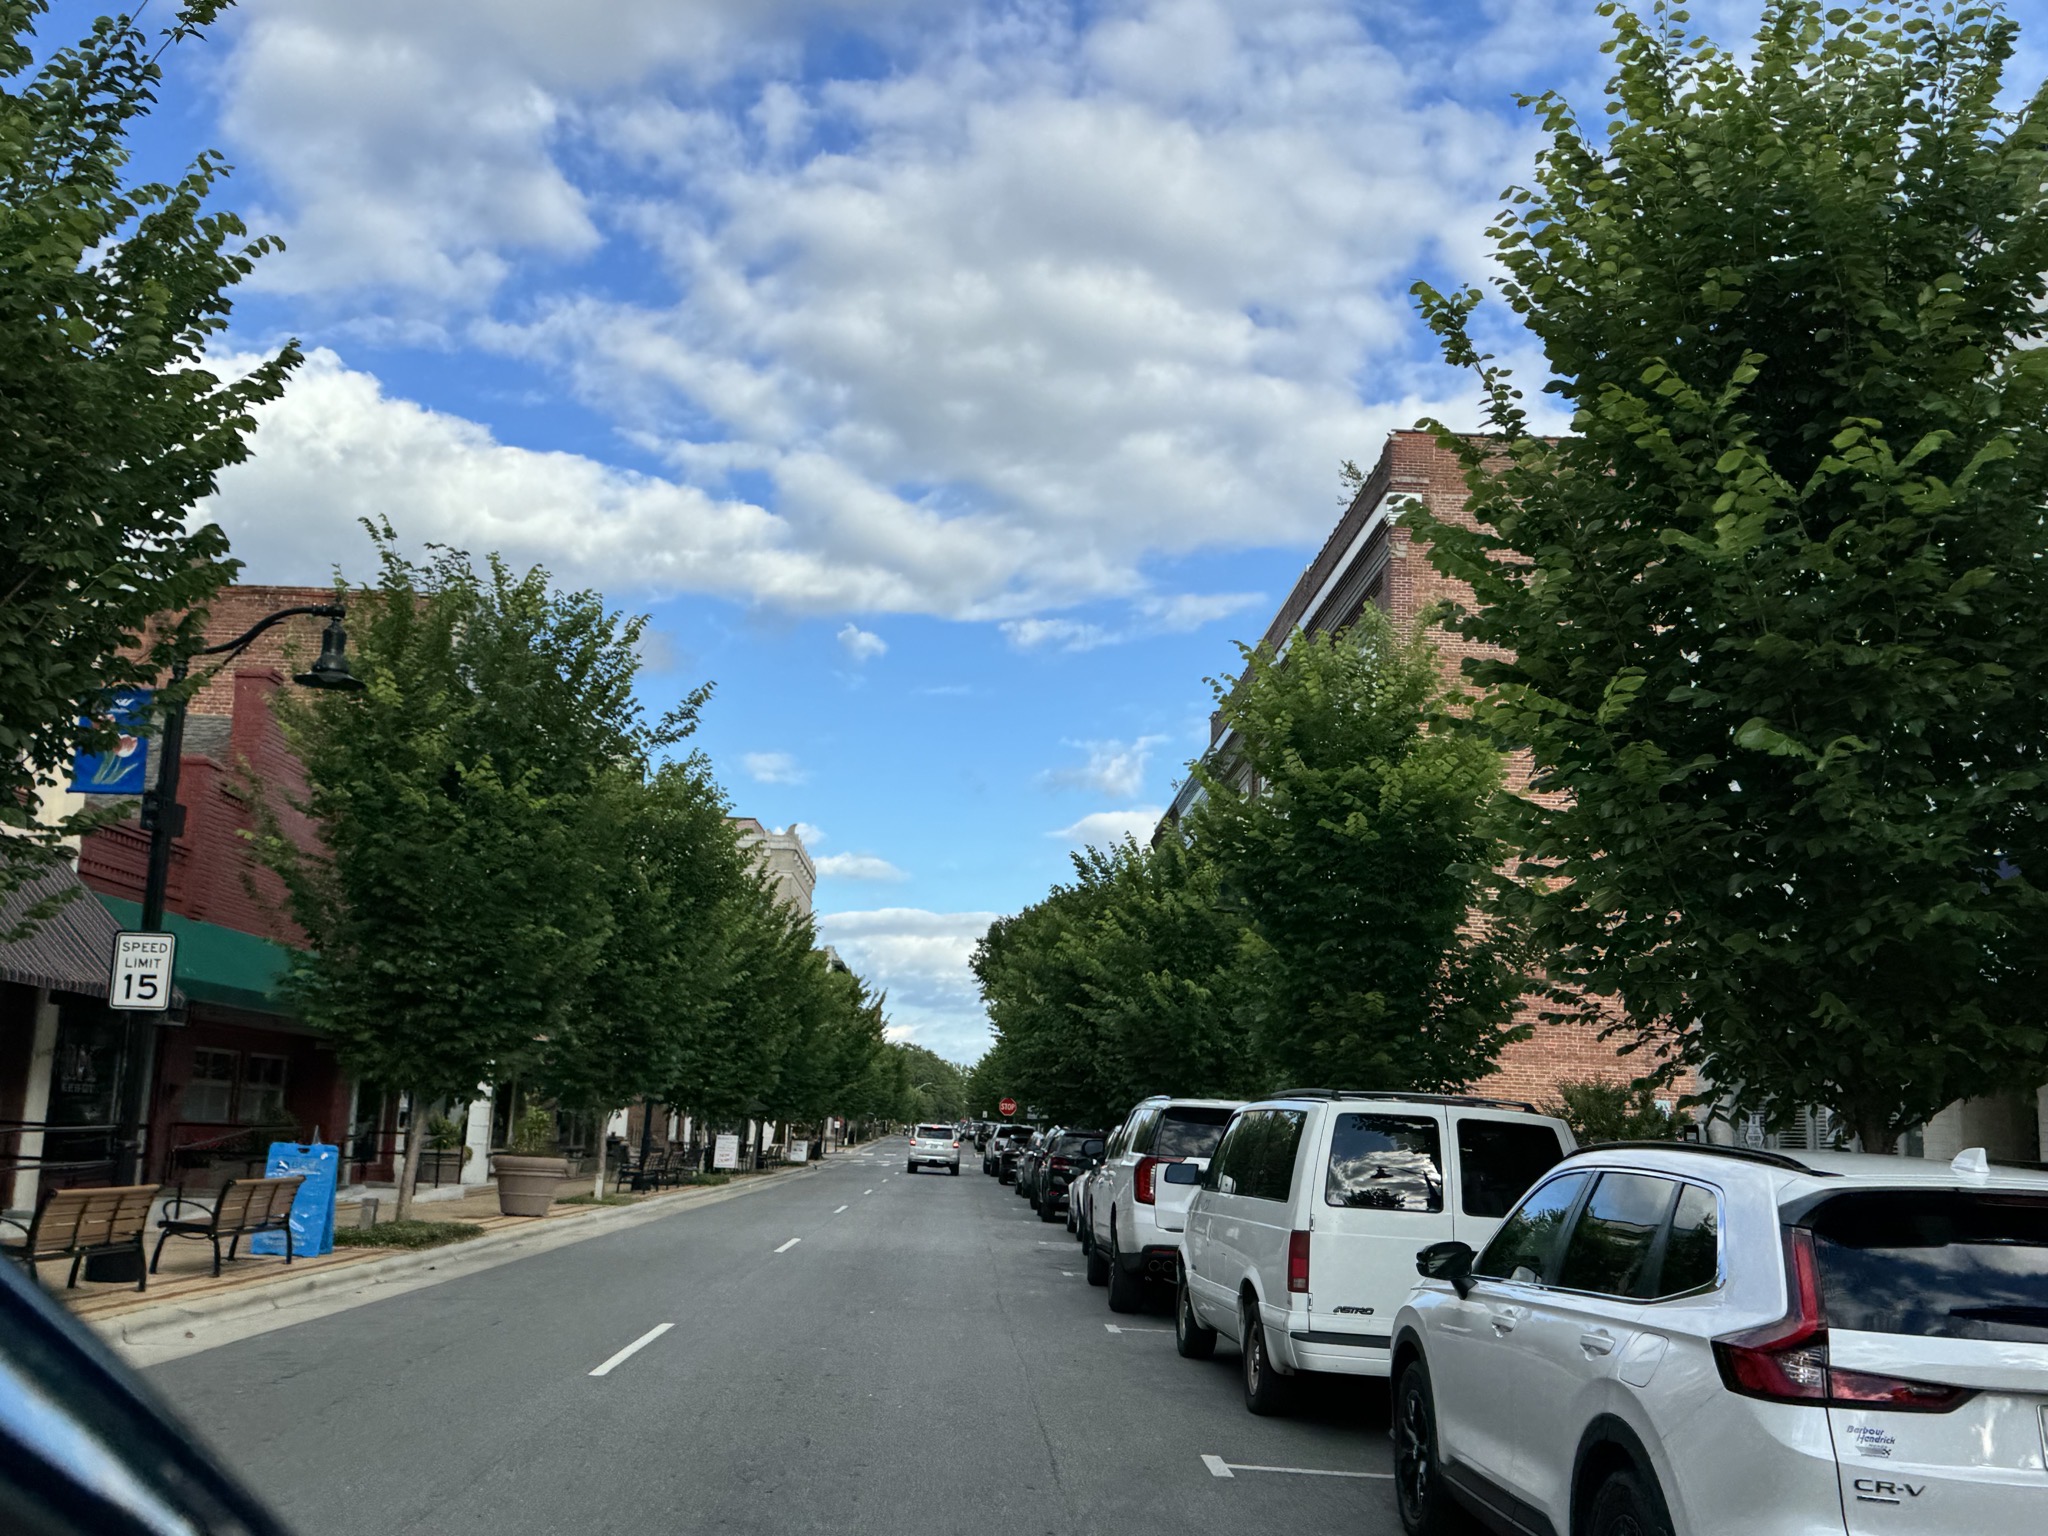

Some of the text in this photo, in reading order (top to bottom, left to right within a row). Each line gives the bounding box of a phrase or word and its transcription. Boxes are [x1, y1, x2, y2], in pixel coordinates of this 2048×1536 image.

[122, 942, 168, 953] SPEED
[125, 957, 161, 968] LIMIT
[124, 974, 158, 1000] 15
[1332, 1305, 1375, 1315] ASTRO
[1846, 1425, 1885, 1436] Barbour
[1856, 1434, 1896, 1444] Hendrick
[1854, 1478, 1926, 1497] CR-V
